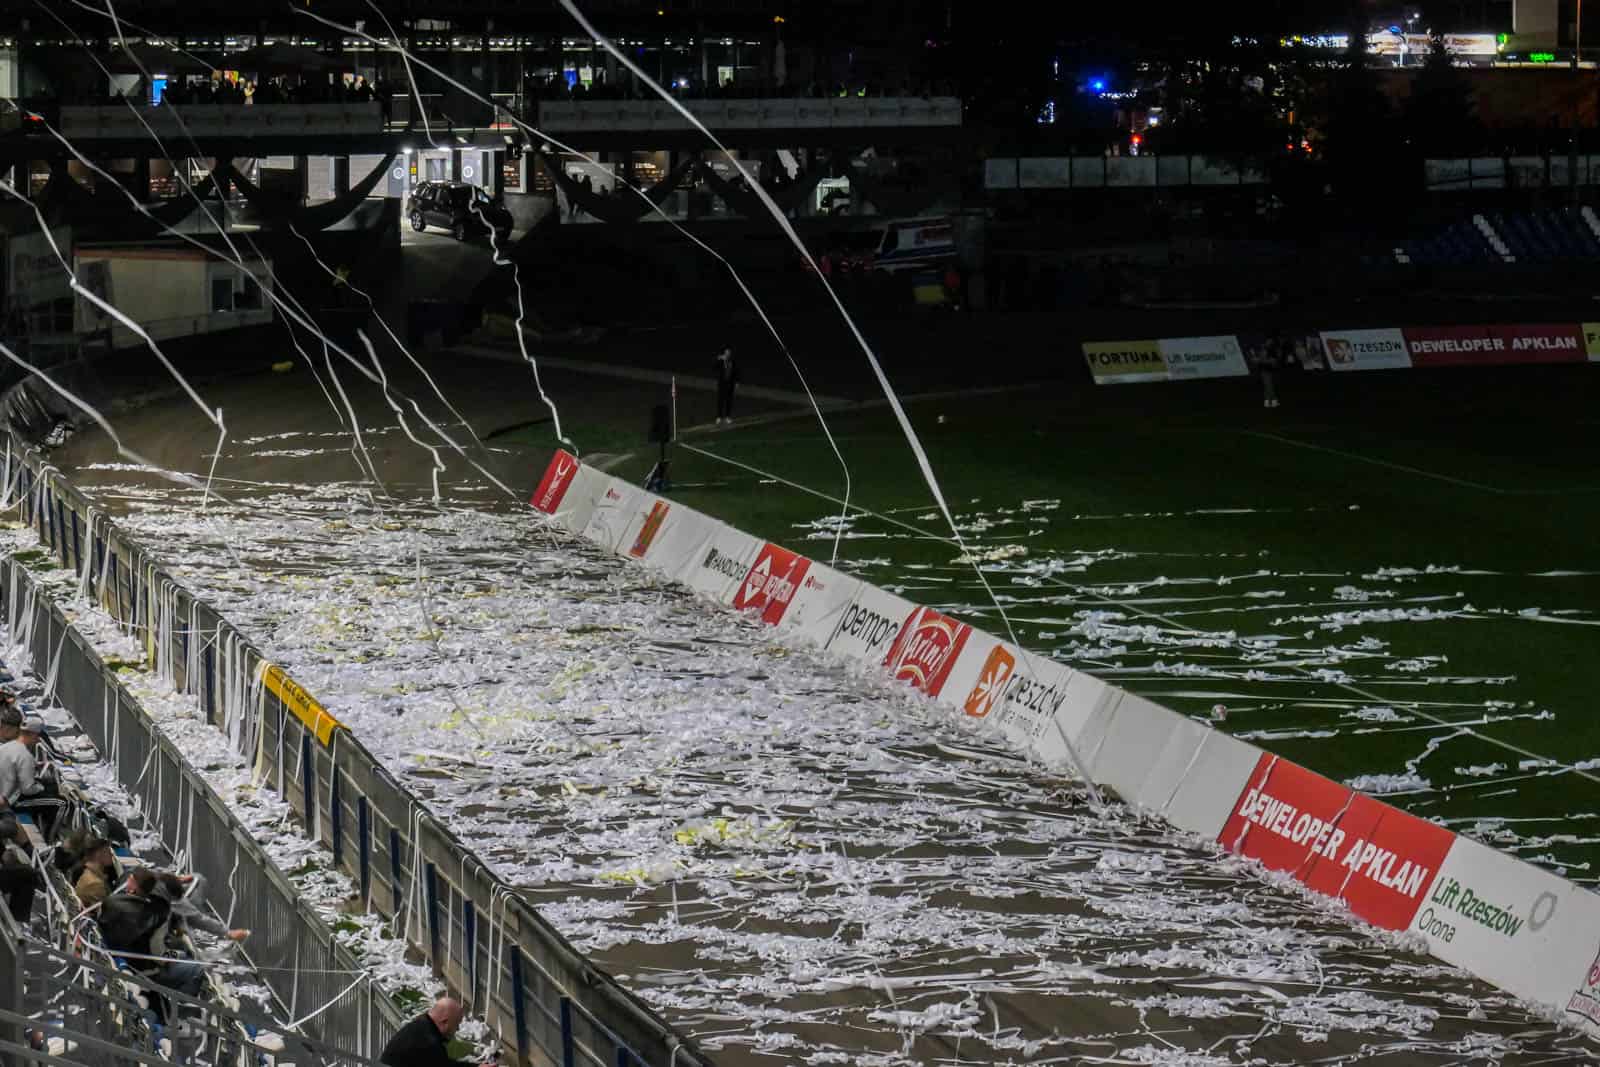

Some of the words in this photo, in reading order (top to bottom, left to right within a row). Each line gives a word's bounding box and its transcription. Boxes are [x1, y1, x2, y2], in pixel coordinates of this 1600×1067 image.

[1088, 351, 1162, 366] FORTUNA
[1411, 337, 1504, 353] DEWELOPER
[1511, 336, 1578, 350] APKLAN
[1239, 788, 1345, 861] DEWELOPER
[1341, 838, 1429, 898] APKLAN
[1419, 907, 1456, 943] Orona
[1431, 877, 1460, 909] Lift
[1456, 888, 1524, 937] Rzeszów
